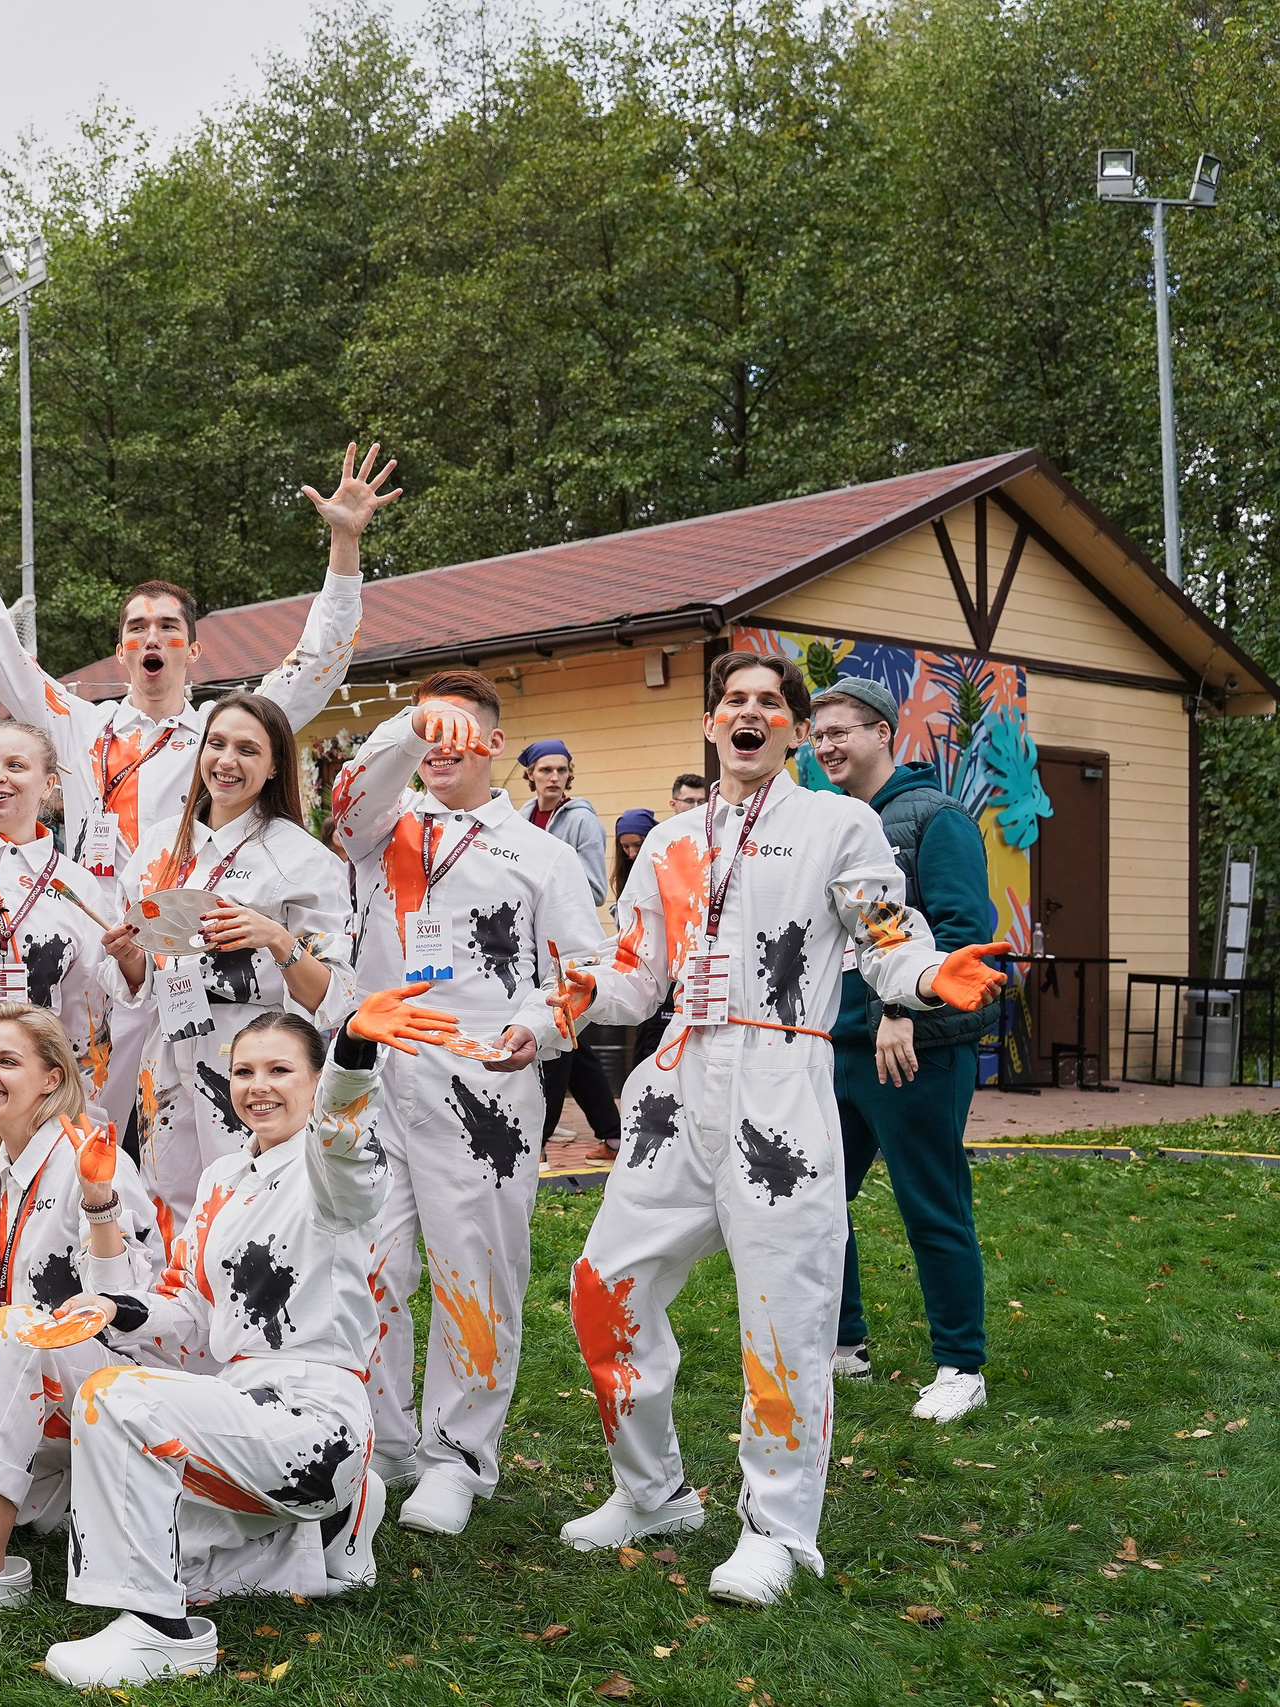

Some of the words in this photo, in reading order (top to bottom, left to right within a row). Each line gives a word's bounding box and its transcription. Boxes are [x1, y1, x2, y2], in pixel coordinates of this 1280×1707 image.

[490, 847, 520, 862] ФСК
[760, 844, 793, 857] ФСК
[225, 868, 252, 880] ФСК
[430, 865, 448, 884] ГОРОДА
[29, 885, 41, 902] ГОРОДА
[417, 925, 440, 934] XVIII
[168, 979, 192, 993] XVIII
[0, 1262, 8, 1289] ГОРОДА
